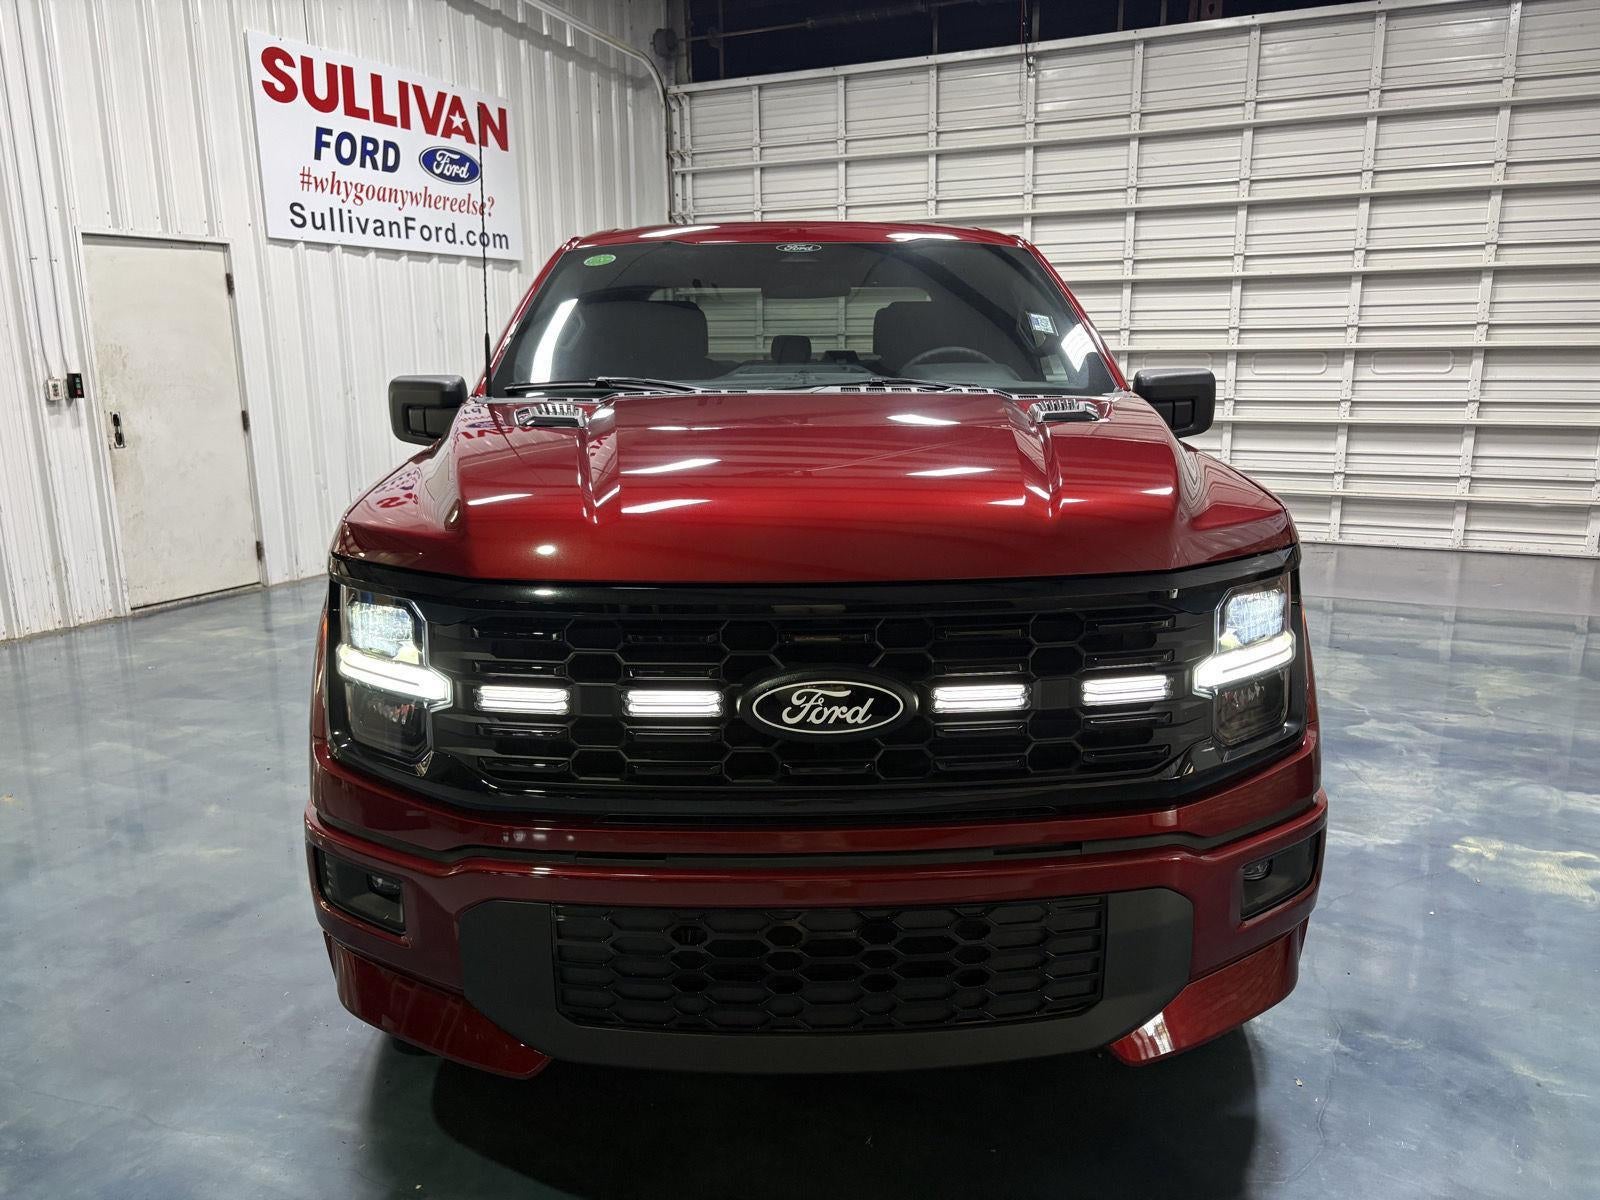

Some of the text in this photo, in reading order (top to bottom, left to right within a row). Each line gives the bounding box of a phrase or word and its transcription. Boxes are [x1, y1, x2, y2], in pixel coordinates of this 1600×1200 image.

[261, 46, 509, 152] SULLIVAN
[313, 126, 401, 173] FORD
[432, 150, 470, 180] Ford
[299, 166, 495, 218] #whygoanywhereelse?
[289, 202, 510, 250] SullivanFord.com
[782, 688, 874, 724] Ford
